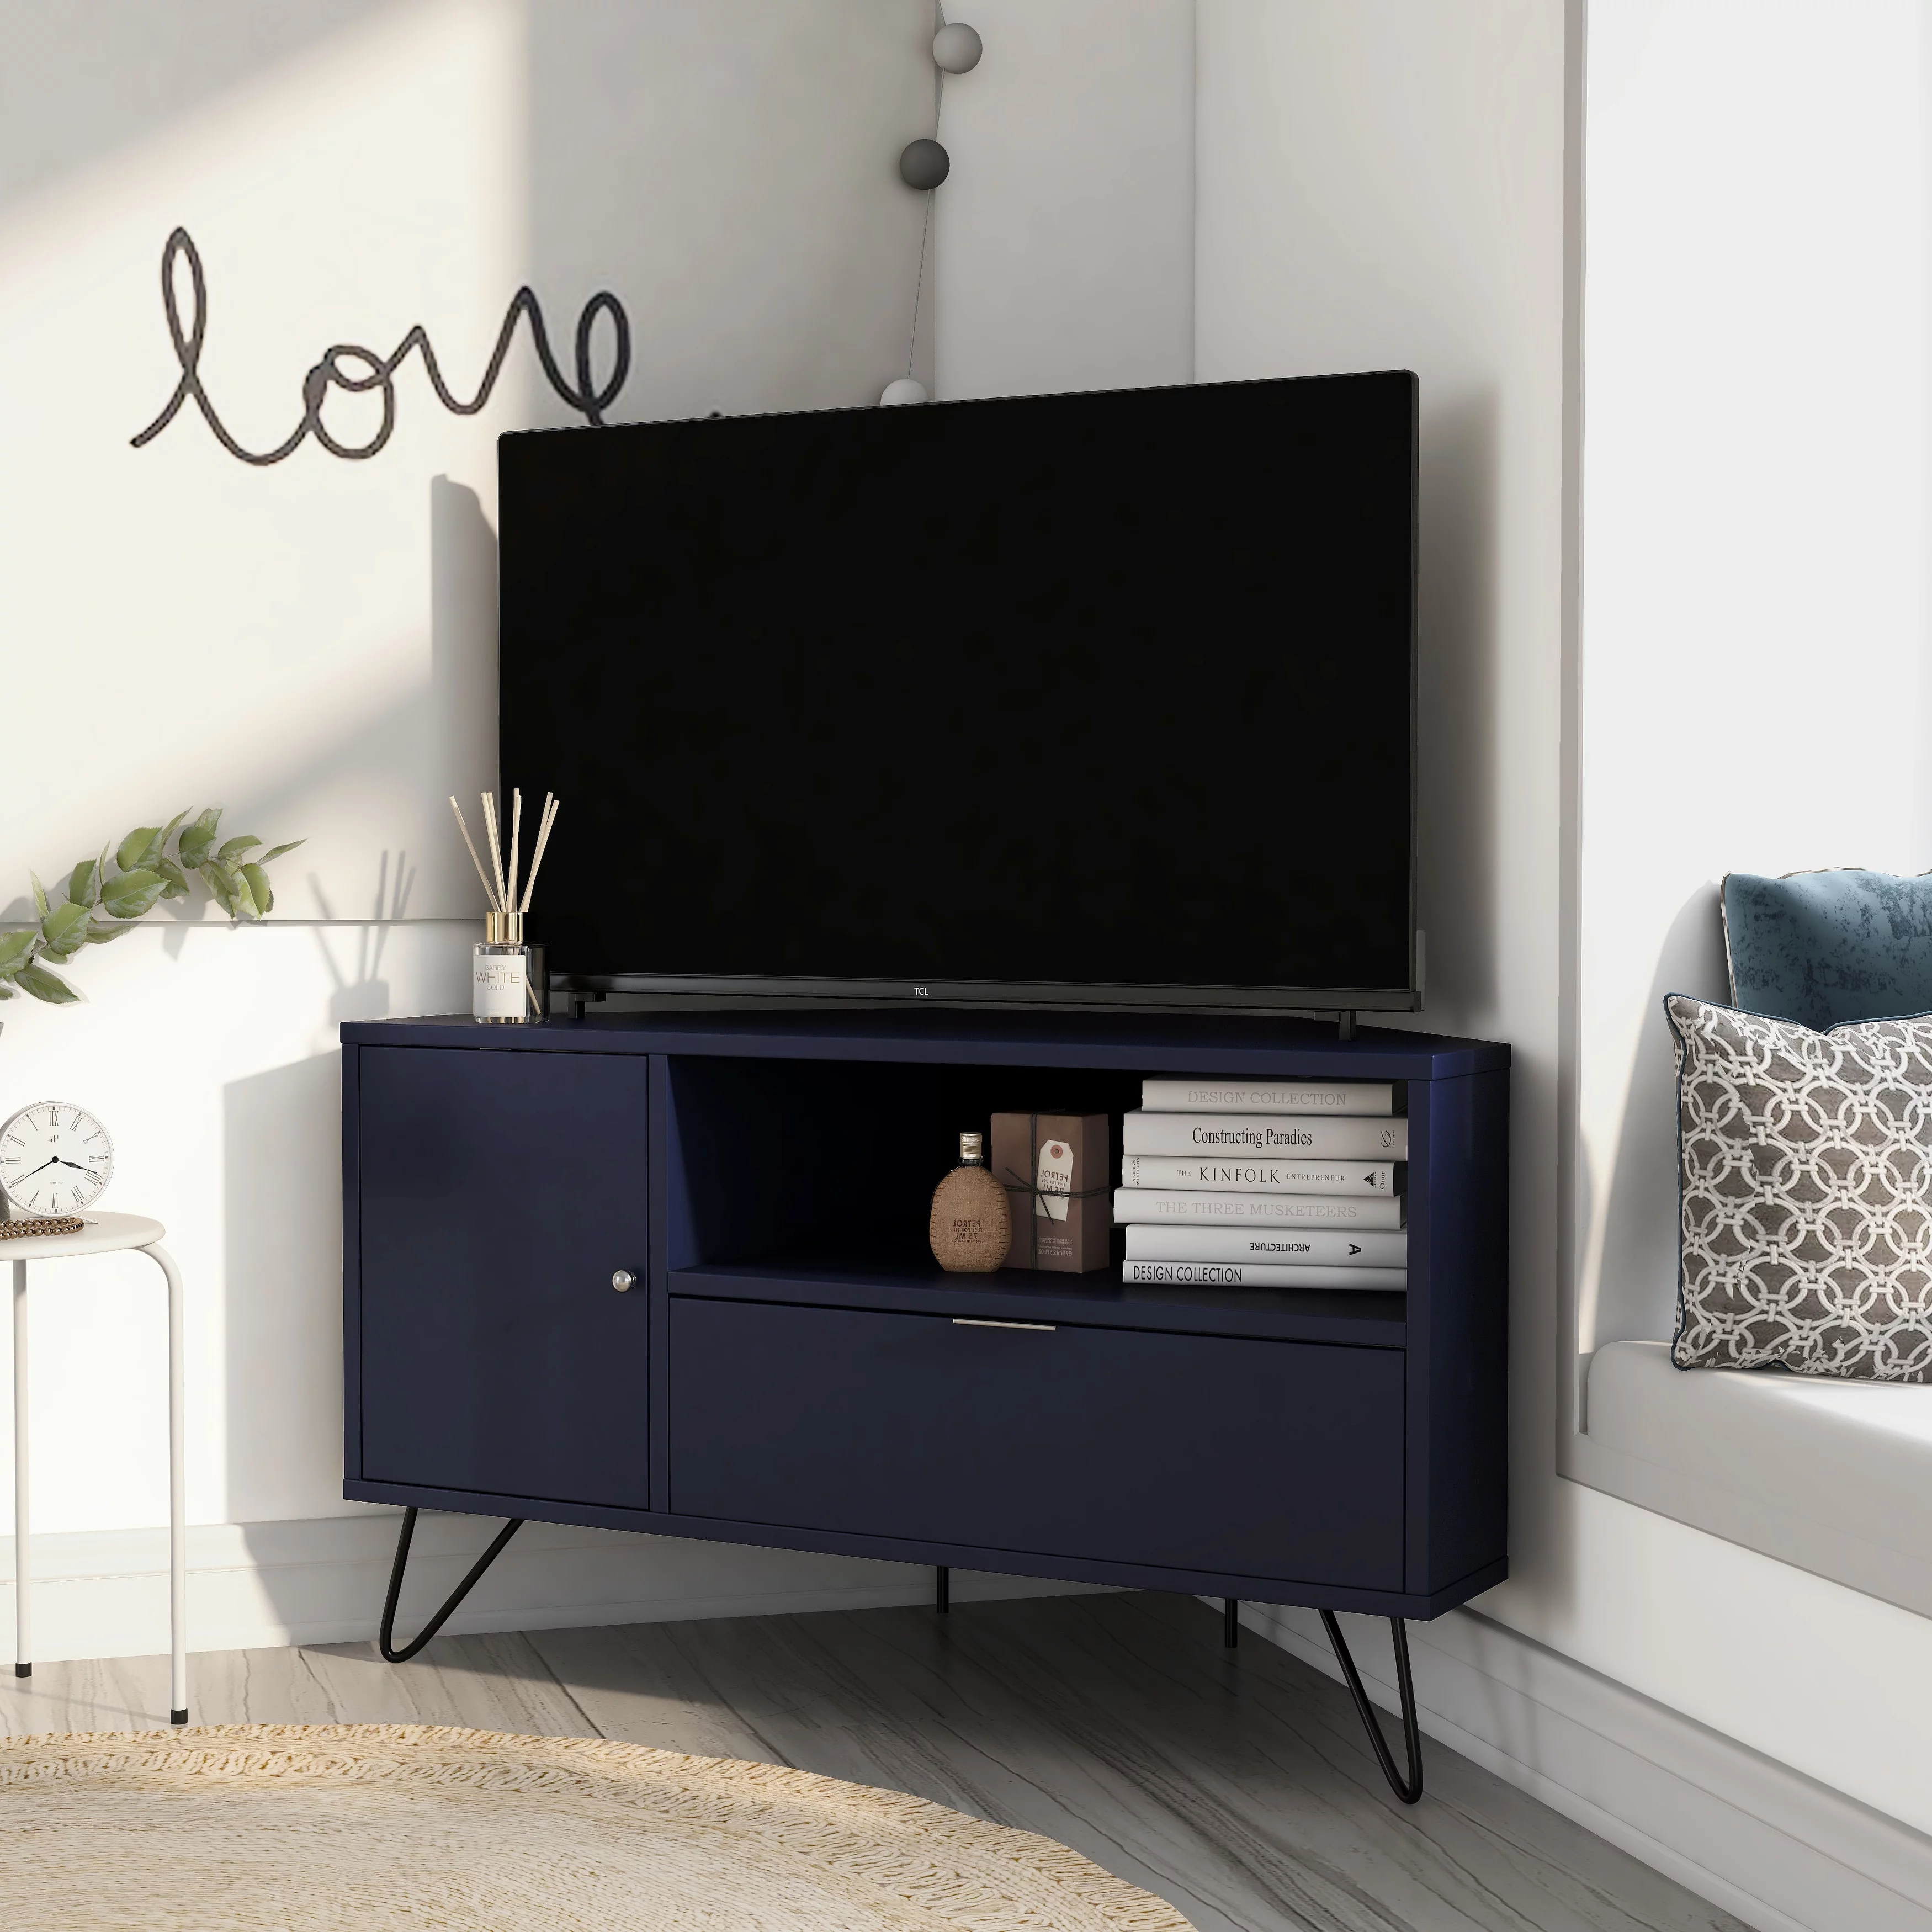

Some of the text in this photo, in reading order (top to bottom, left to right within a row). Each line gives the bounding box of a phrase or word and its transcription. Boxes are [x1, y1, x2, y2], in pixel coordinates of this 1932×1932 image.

[130, 227, 630, 466] love
[476, 972, 520, 984] WHITE
[914, 987, 929, 995] TCL
[1187, 1091, 1346, 1105] DESIGN COLLECTION
[1192, 1127, 1312, 1148] Constructing Paradies
[1199, 1167, 1280, 1183] KINFOLK
[1287, 1173, 1345, 1181] ENTREPRENEUR
[1156, 1201, 1357, 1218] THE THREE MUSKETEERS
[1250, 1243, 1362, 1256] ARCHITECTURE A
[1134, 1266, 1242, 1283] DESIGN COLLECTION
